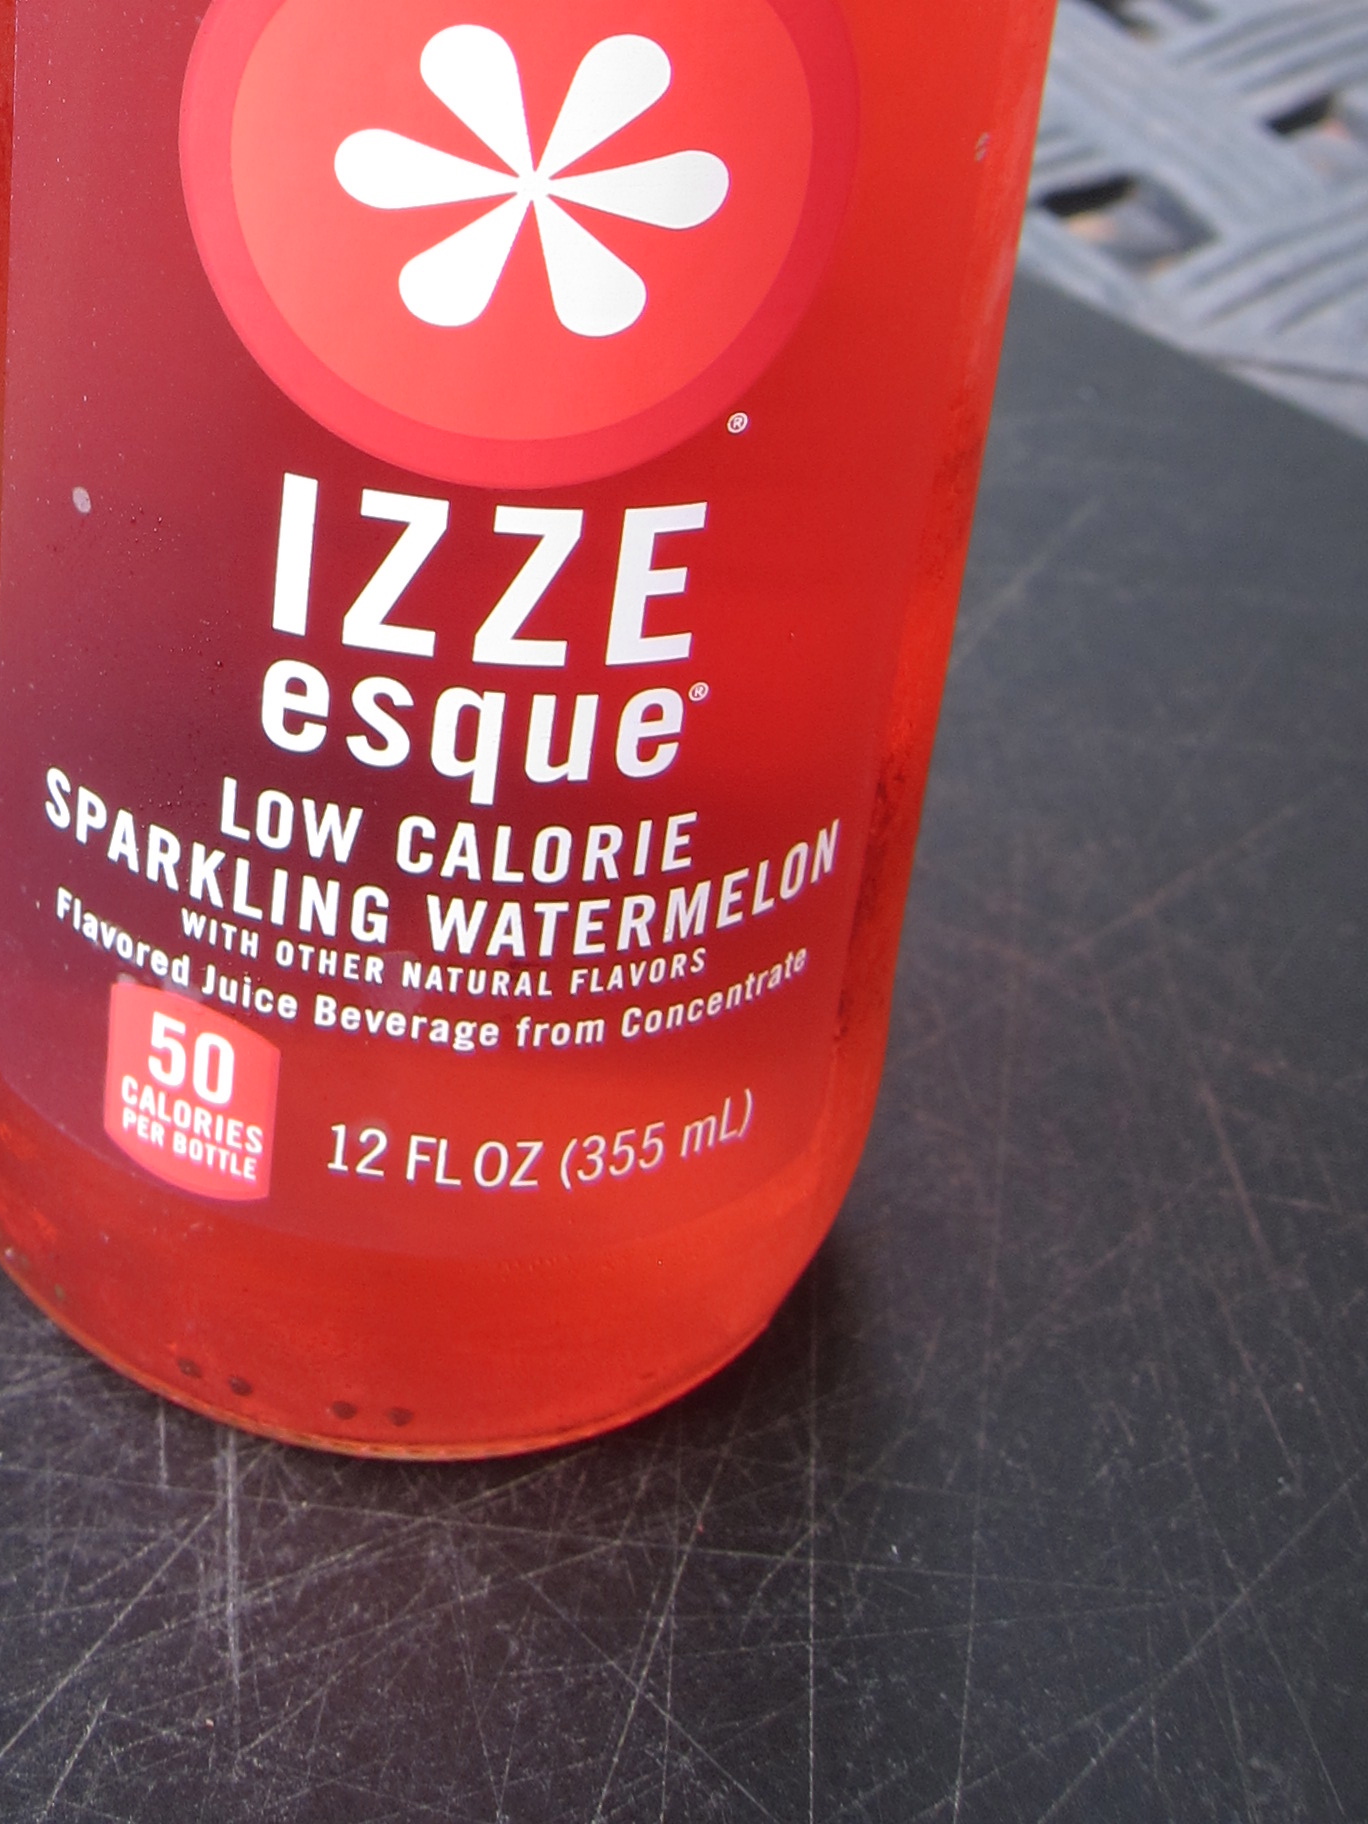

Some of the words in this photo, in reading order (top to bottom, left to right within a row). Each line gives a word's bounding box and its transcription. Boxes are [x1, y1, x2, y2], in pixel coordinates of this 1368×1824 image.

[272, 472, 707, 667] IZZE
[45, 767, 389, 944] SPARKLING
[426, 820, 839, 957] WATERMELON
[220, 776, 364, 863] LOW
[396, 811, 698, 884] CALORIE
[56, 887, 190, 988] Flavored
[201, 964, 298, 1019] Juice
[314, 994, 499, 1052] Beverage
[516, 1016, 605, 1047] from
[621, 948, 807, 1038] Concentrate
[181, 907, 259, 959] WITH
[275, 940, 384, 984] OTHER
[401, 960, 552, 997] NATURAL
[570, 947, 706, 995] FLAVORS
[147, 1011, 235, 1105] 50
[121, 1075, 263, 1154] CALORIES
[122, 1106, 165, 1147] PER
[172, 1130, 257, 1180] BOTTLE
[327, 1124, 388, 1177] 12
[406, 1135, 461, 1186] FL
[474, 1141, 543, 1188] OZ
[560, 1122, 665, 1190] (355
[680, 1088, 753, 1158] mL)
